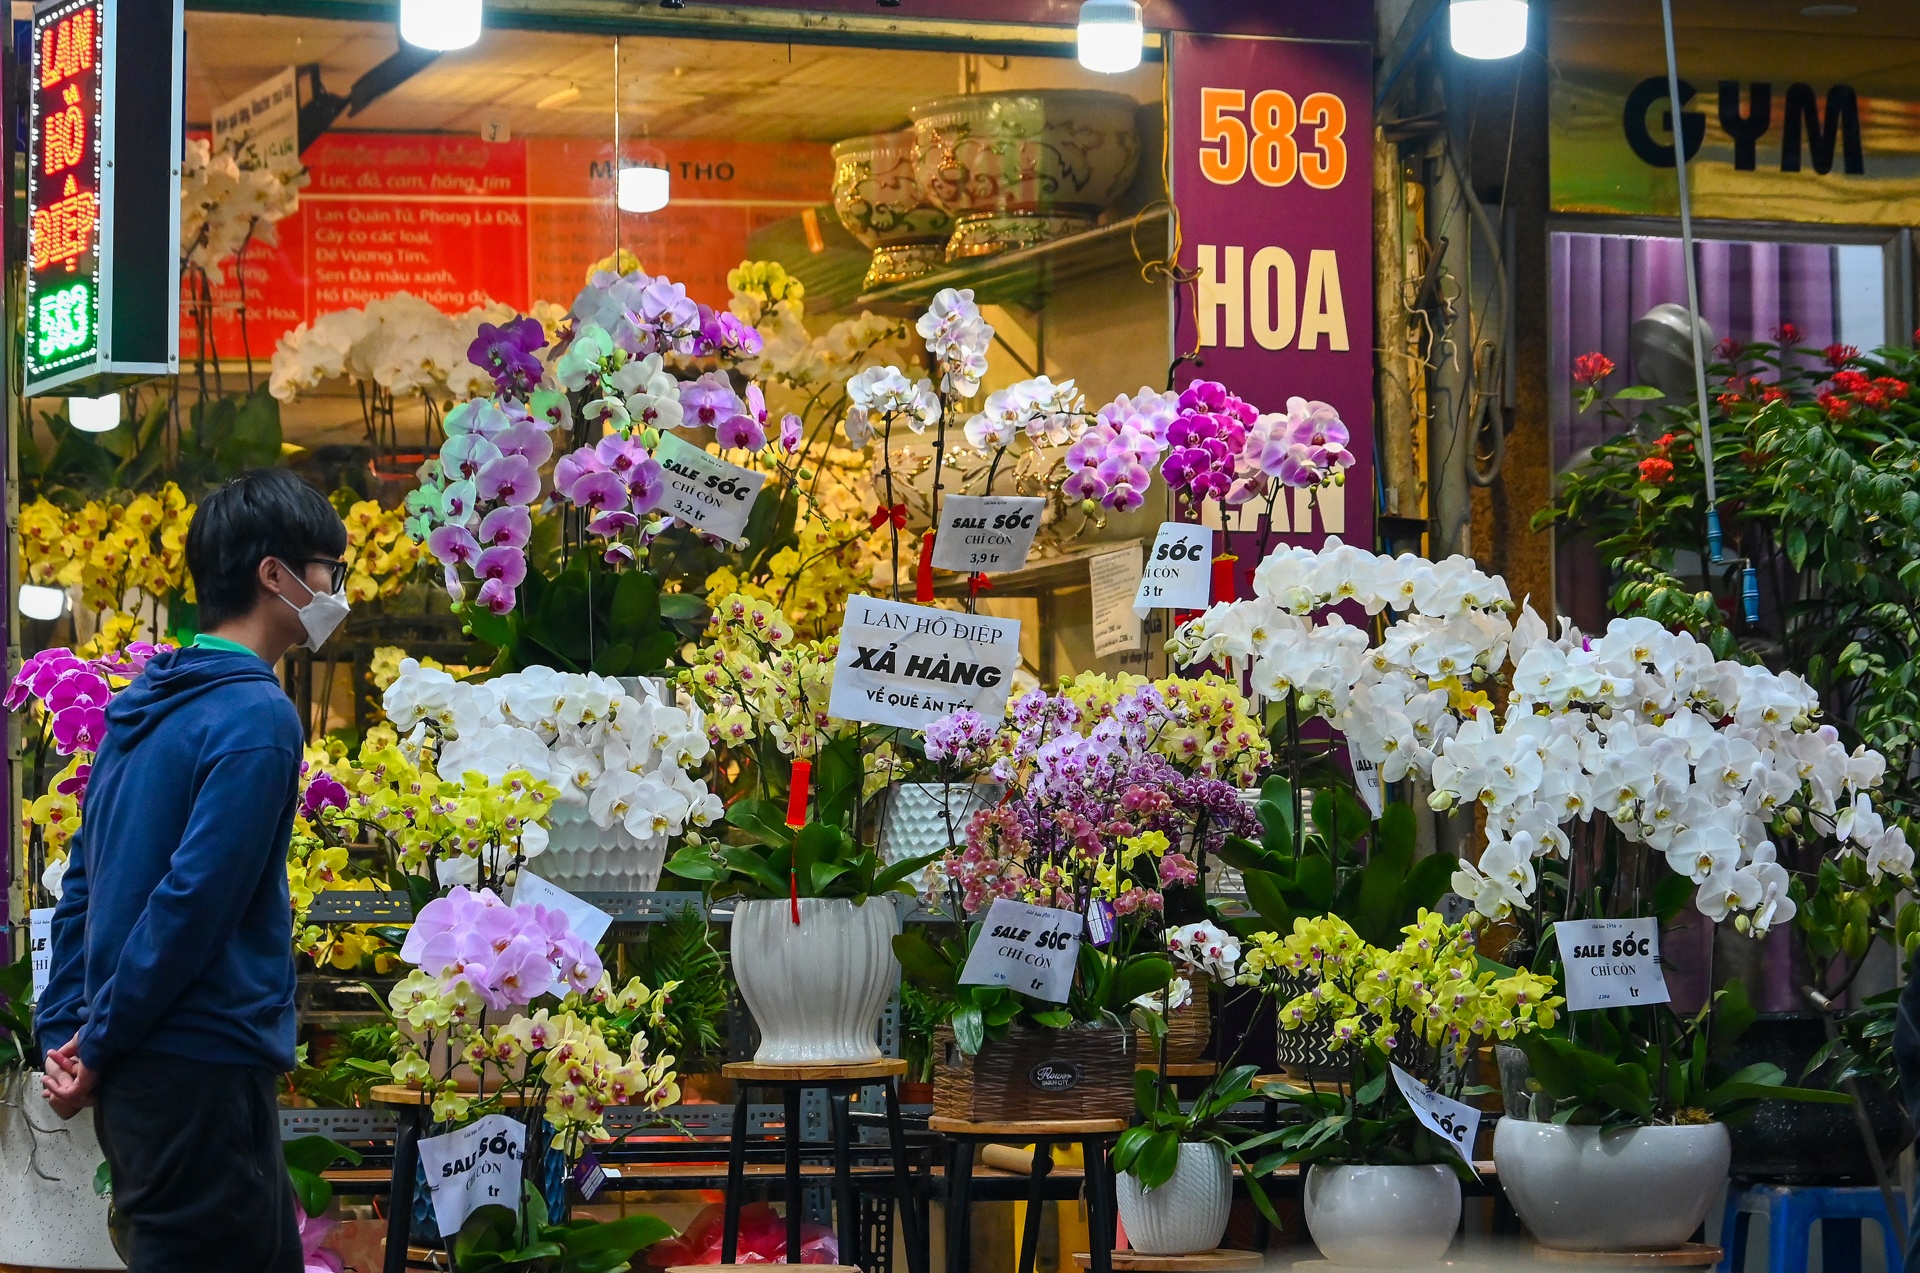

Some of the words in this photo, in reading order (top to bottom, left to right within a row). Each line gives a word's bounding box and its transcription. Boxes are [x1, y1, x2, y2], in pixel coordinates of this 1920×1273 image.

[42, 9, 93, 88] LAN
[46, 84, 84, 174] HỒ
[1199, 87, 1347, 189] 583
[1623, 76, 1865, 175] GYM
[1198, 244, 1350, 351] HOA
[663, 459, 700, 480] SALE
[704, 476, 750, 501] SỐC
[674, 500, 693, 515] 3,2
[694, 510, 706, 521] tr
[952, 518, 987, 529] SALE
[993, 507, 1034, 529] SỐC
[988, 534, 1013, 545] CÒN
[1156, 536, 1204, 562] SỐC
[970, 553, 987, 565] 3,9
[990, 553, 1000, 563] tr
[1153, 567, 1180, 579] CÒN
[1154, 585, 1163, 597] tr
[862, 609, 910, 631] LAN
[915, 616, 947, 636] HỒ
[953, 624, 1003, 646] ĐIỆP
[849, 643, 898, 674] XẢ
[904, 653, 1002, 687] HÀNG
[867, 686, 885, 703] VỀ
[888, 694, 920, 709] QUÊ
[922, 697, 944, 713] ĂN
[991, 925, 1032, 942] SALE
[1034, 922, 1072, 950] SỐC
[1573, 945, 1606, 958] SALE
[1612, 930, 1650, 957] SỐC
[1613, 962, 1637, 976] CÒN
[1031, 978, 1043, 990] tr
[1629, 986, 1639, 998] tr
[478, 1129, 517, 1160] SỐC
[488, 1185, 500, 1197] tr
